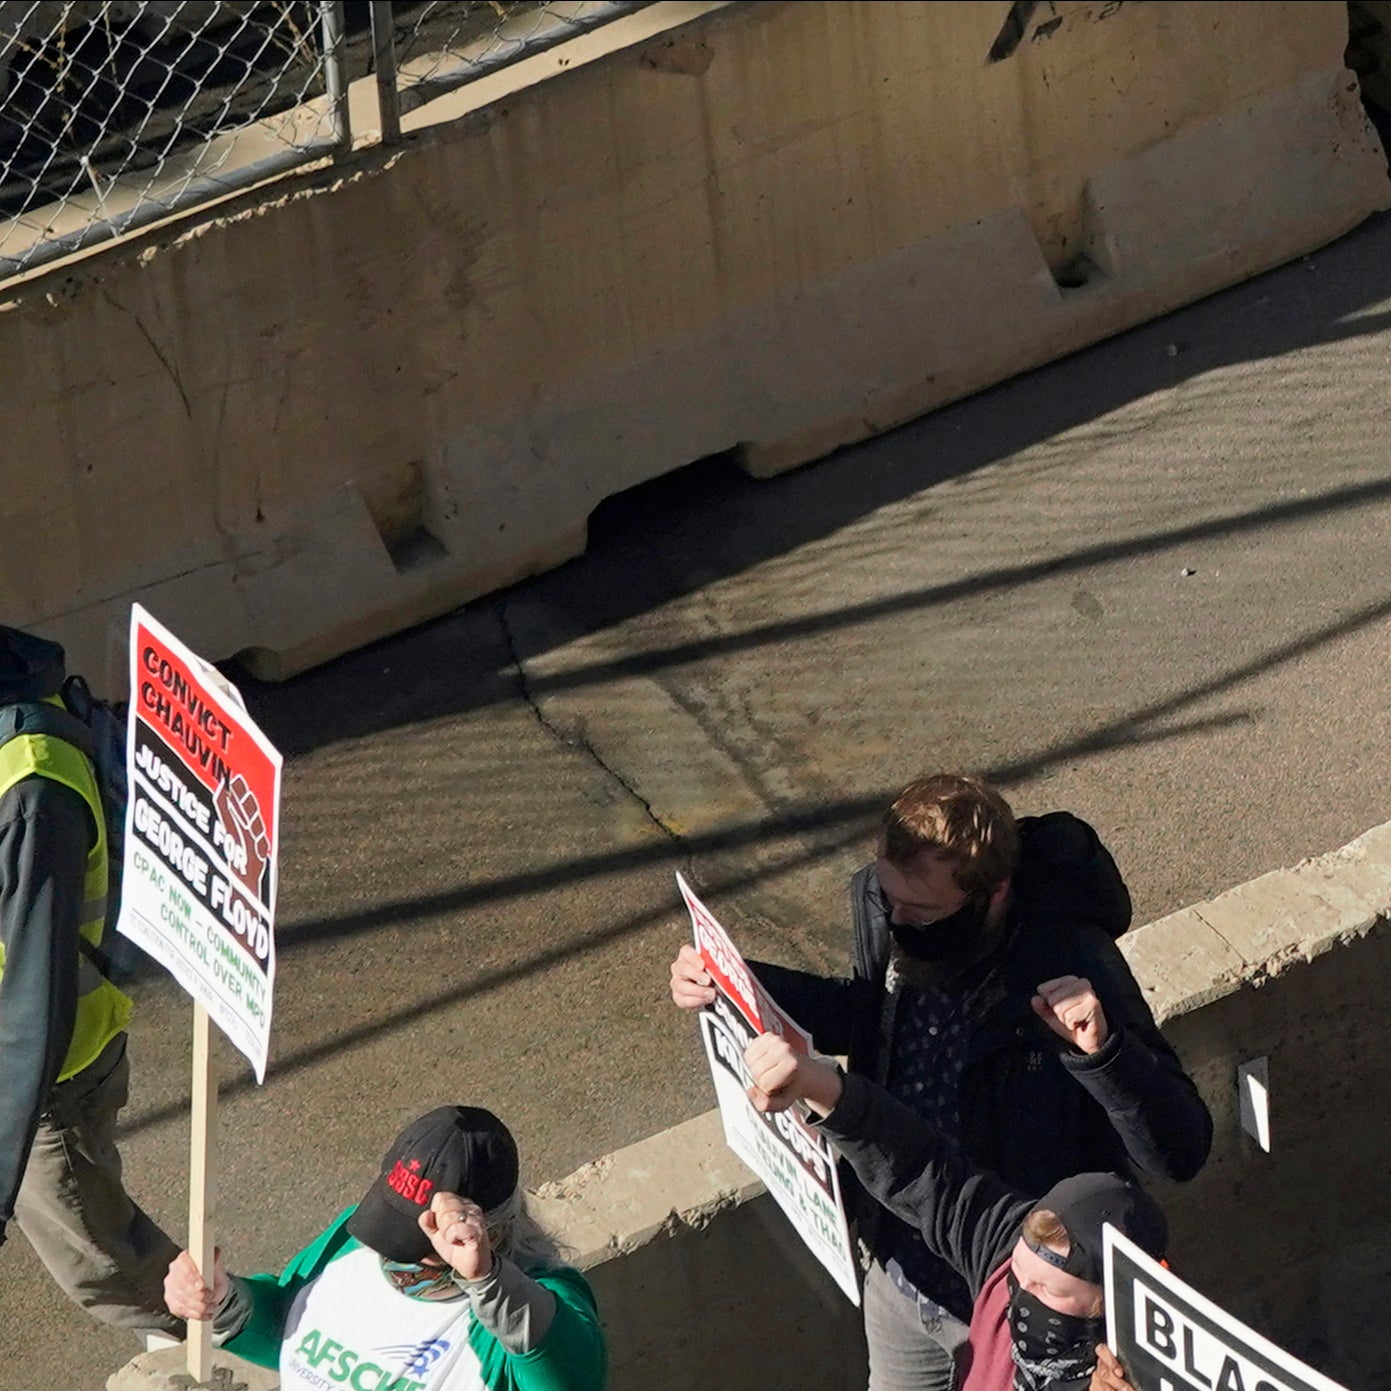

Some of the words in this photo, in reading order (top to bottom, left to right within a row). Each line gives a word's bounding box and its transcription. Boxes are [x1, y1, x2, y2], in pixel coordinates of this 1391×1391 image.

[141, 681, 231, 791] CHAUVIN
[143, 647, 232, 751] CONVICT
[136, 744, 210, 833] JUSTICE
[214, 821, 248, 875] FOR
[133, 852, 166, 892] CPAC
[169, 885, 191, 918] NOW
[207, 926, 267, 1000] COMMUNITY
[134, 798, 209, 896] GEORGE
[211, 875, 269, 960] FLOYD
[160, 903, 210, 968] CONTROL
[214, 962, 243, 1002] OVER
[776, 1112, 827, 1183] COPS
[803, 1178, 838, 1225] LANE
